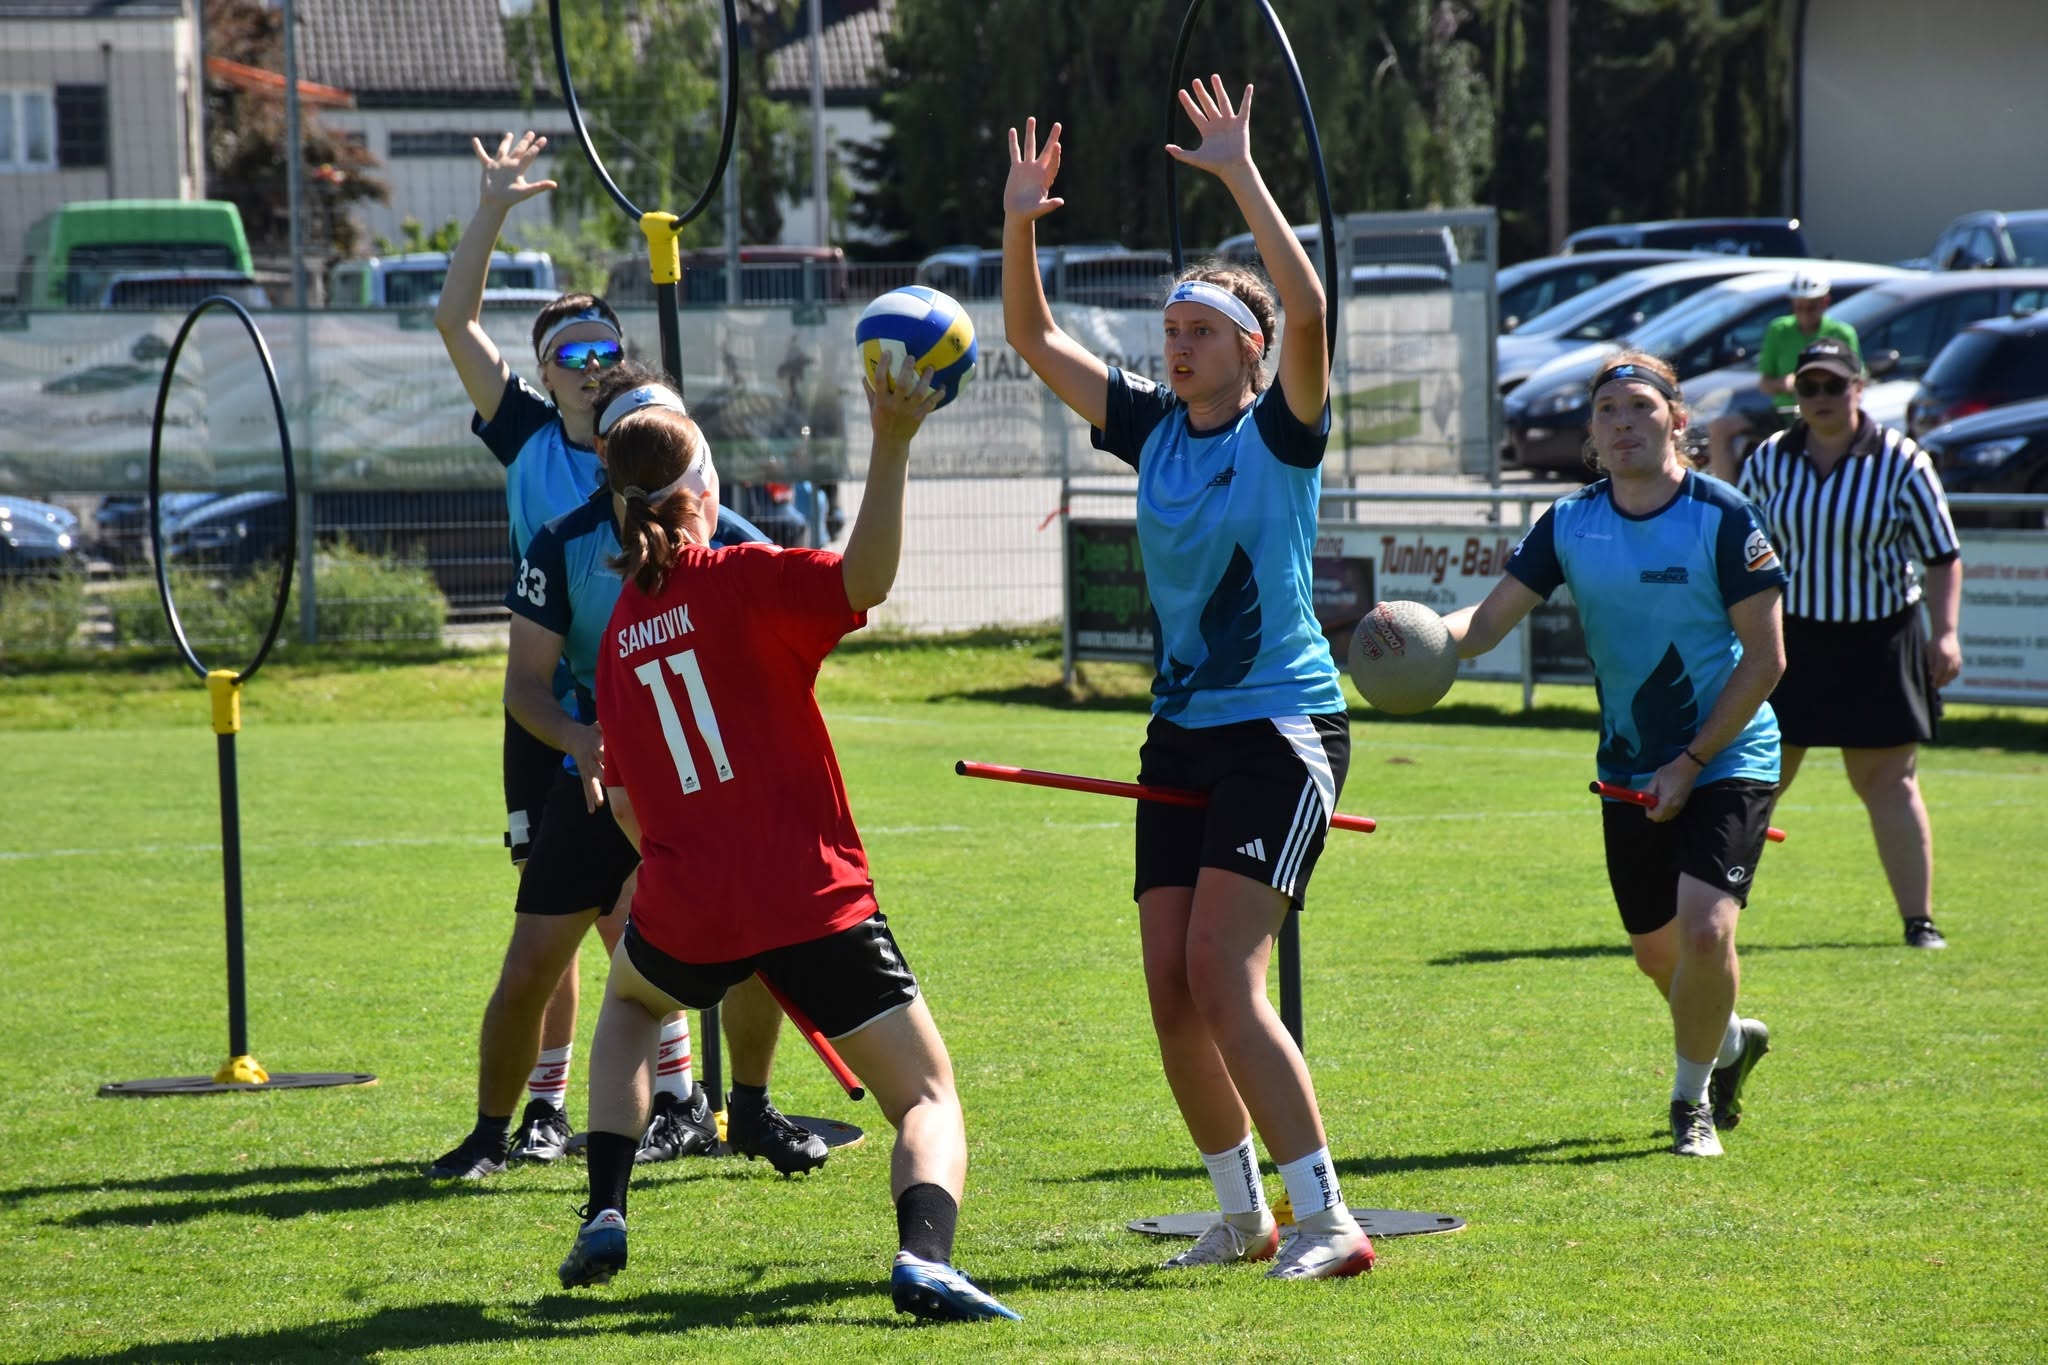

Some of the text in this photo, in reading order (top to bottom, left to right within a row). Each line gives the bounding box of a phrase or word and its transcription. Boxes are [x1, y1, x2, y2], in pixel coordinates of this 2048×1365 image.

[517, 558, 547, 607] 33
[618, 603, 695, 659] SANDVIK
[634, 648, 735, 795] 11
